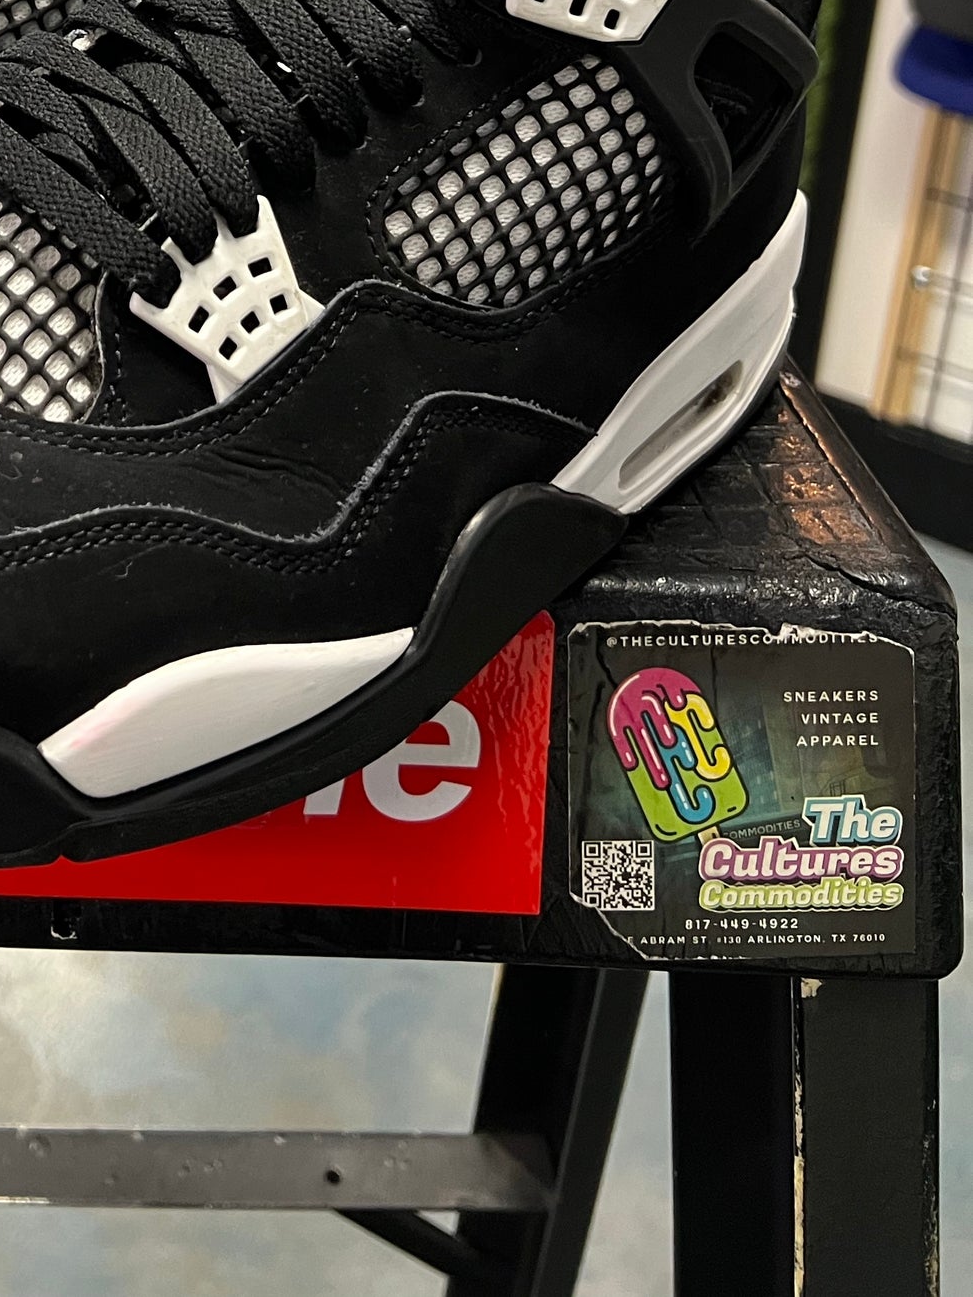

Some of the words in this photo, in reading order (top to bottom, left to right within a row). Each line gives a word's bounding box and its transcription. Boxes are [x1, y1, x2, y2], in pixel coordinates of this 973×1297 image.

[783, 691, 878, 702] SNEAKERS
[801, 712, 879, 724] VINTAGE
[796, 735, 879, 746] APPAREL
[809, 800, 897, 840] The
[703, 841, 899, 878] Cultures
[702, 878, 901, 908] Commodities
[685, 918, 798, 930] 817-449-4922
[831, 934, 847, 942] TX
[852, 933, 886, 942] 76010
